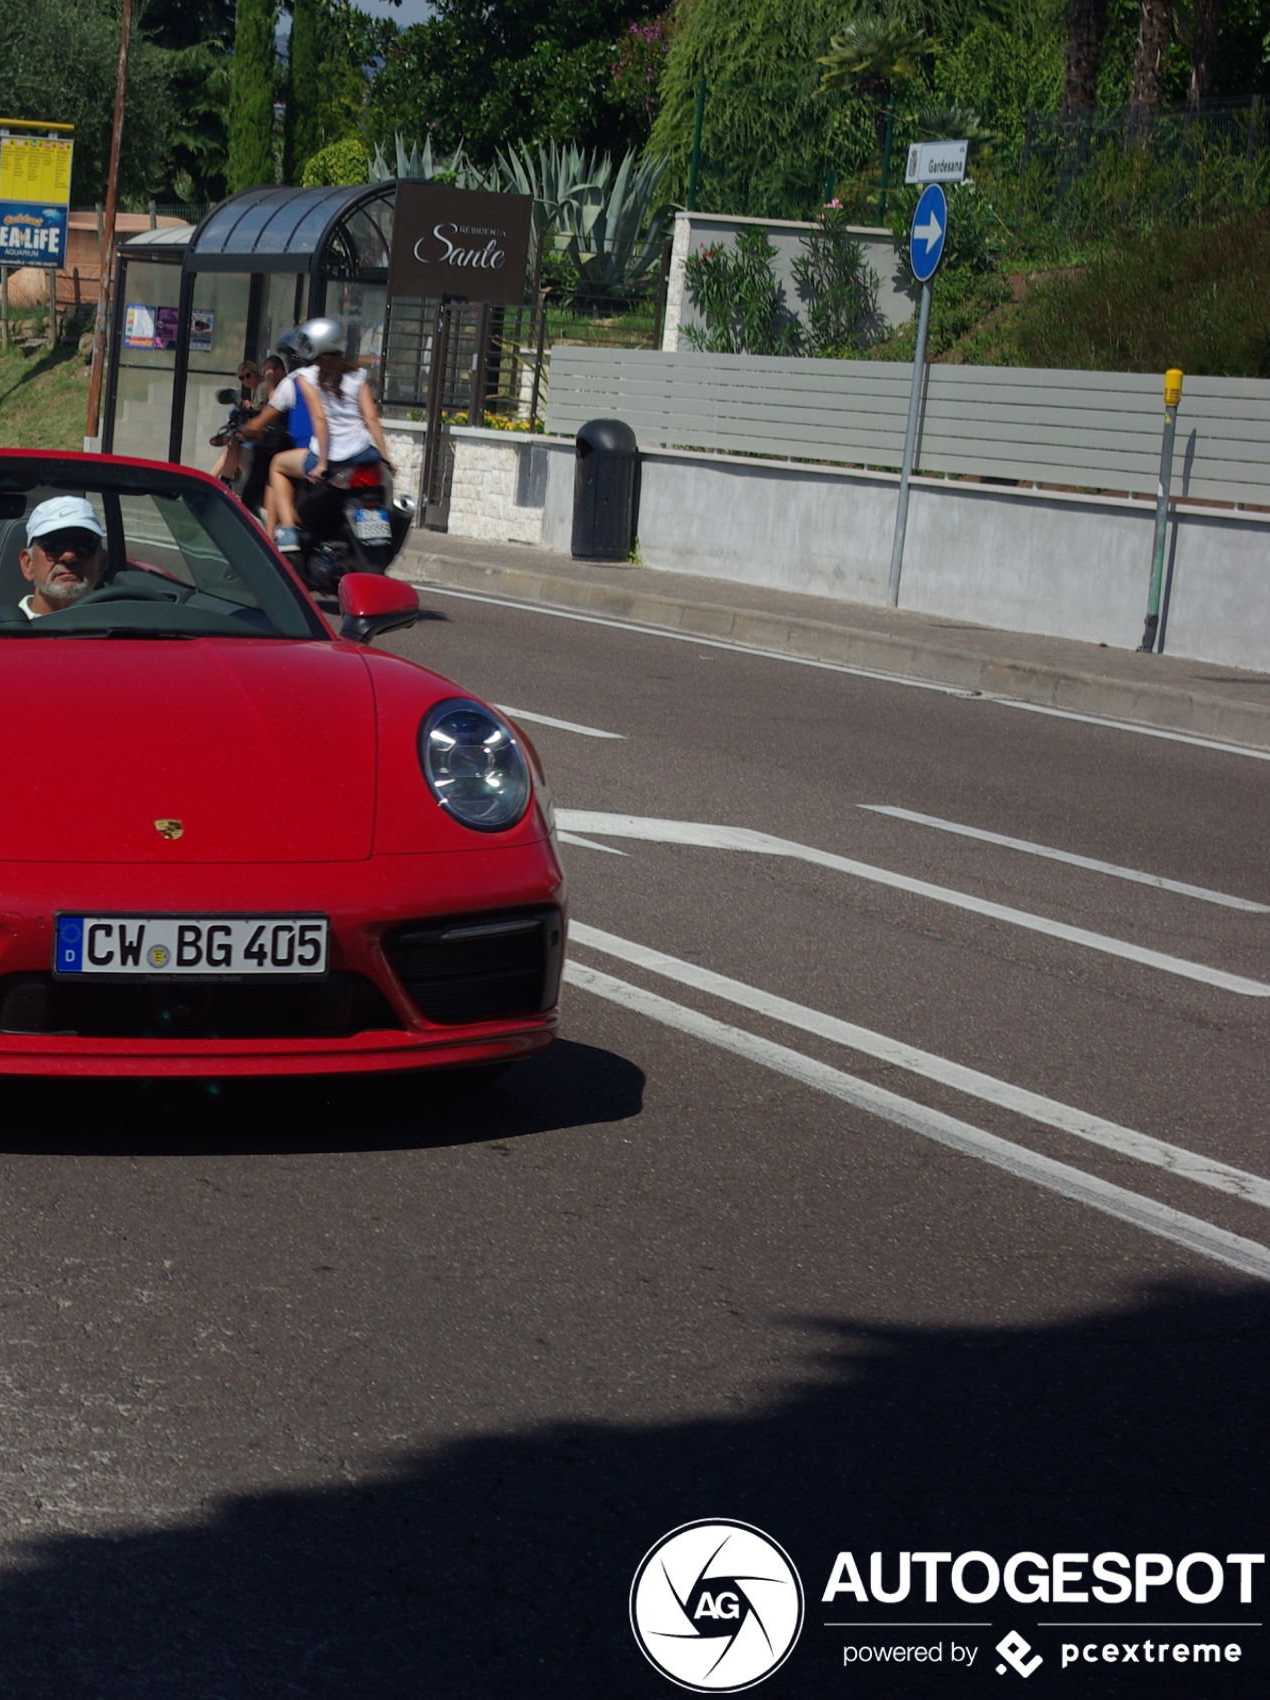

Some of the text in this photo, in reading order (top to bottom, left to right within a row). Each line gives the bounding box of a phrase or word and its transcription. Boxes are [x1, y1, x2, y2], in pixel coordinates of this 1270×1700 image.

[929, 158, 962, 173] Gardesana
[459, 226, 506, 237] RESIDENZA
[4, 248, 39, 257] AQUARIUM
[87, 924, 322, 967] CW BG 405
[65, 950, 75, 962] D
